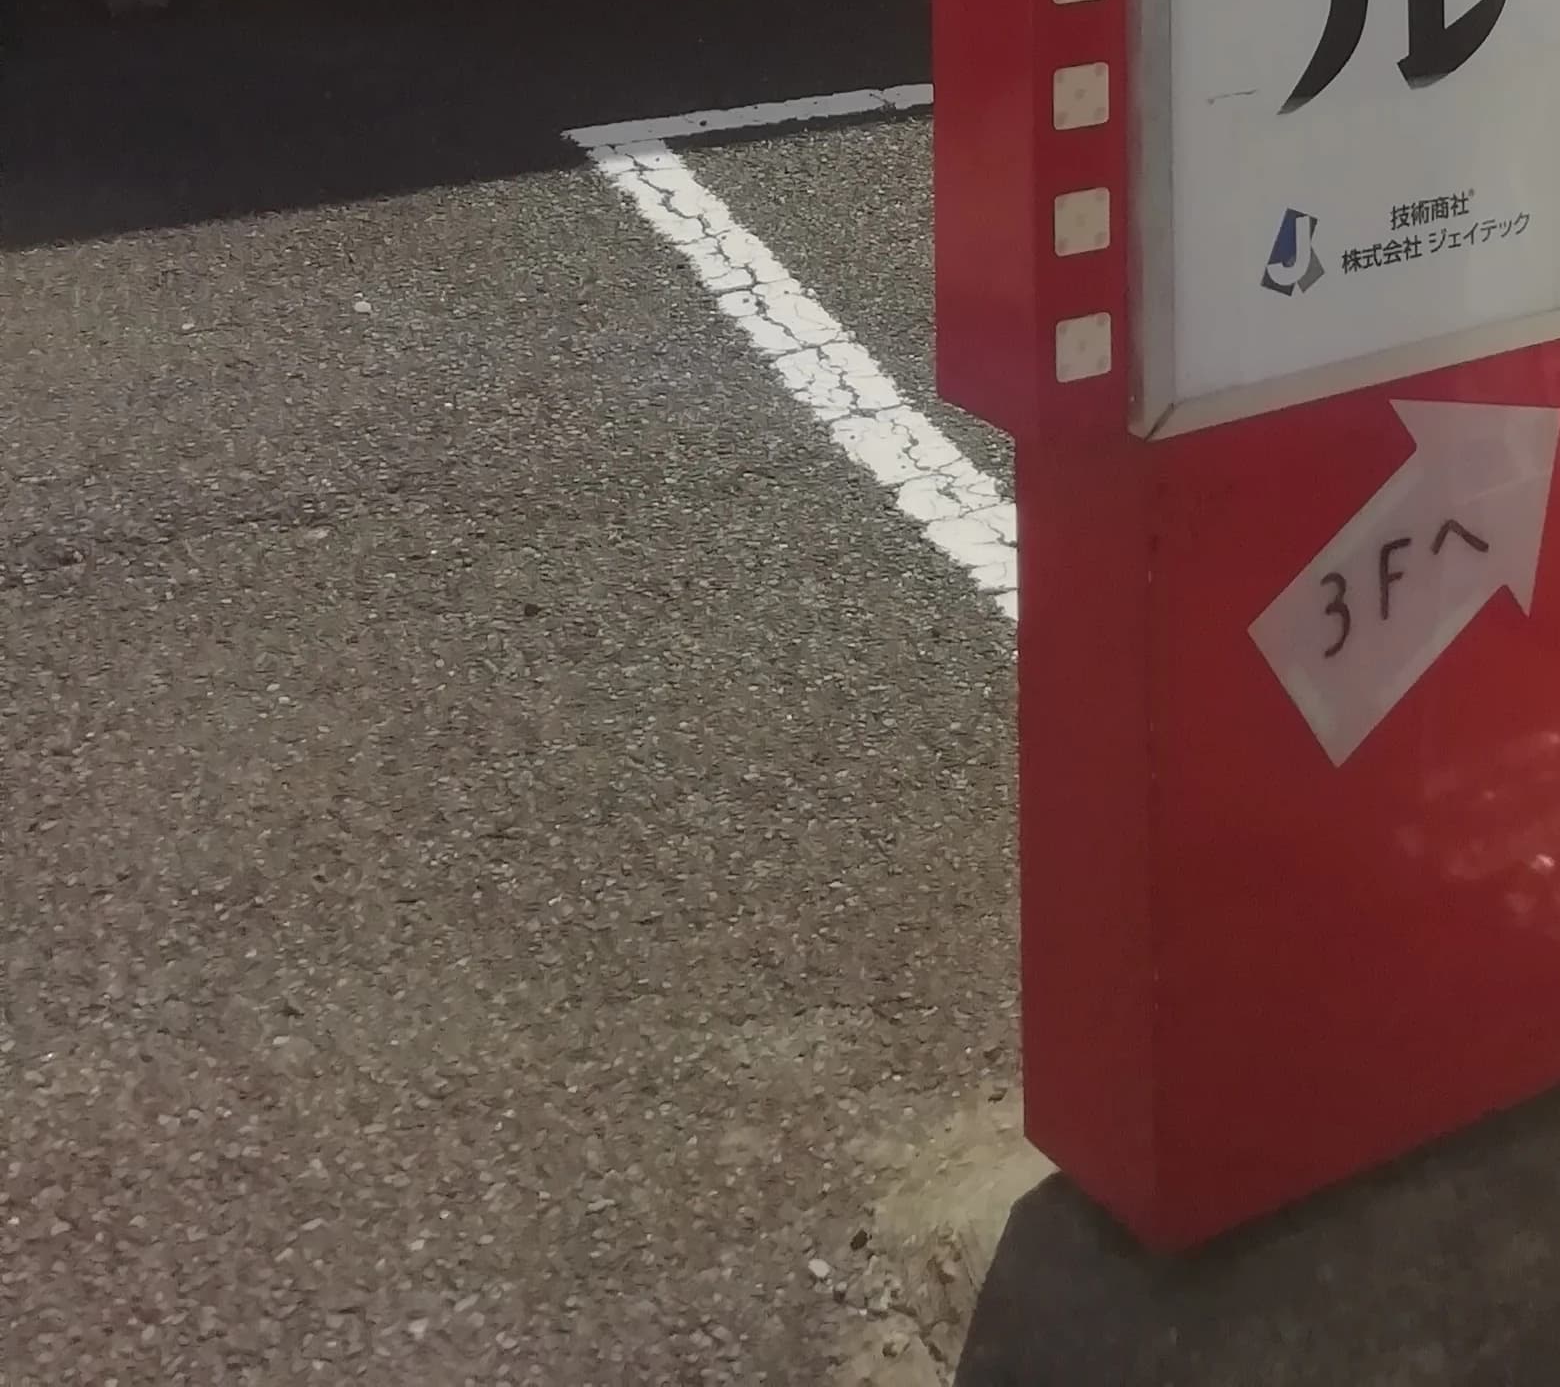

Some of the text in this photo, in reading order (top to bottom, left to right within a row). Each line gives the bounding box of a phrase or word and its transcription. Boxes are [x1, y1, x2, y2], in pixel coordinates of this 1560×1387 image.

[1389, 190, 1471, 231] 技術商社
[1340, 211, 1531, 275] 株式会社 ジェイテック
